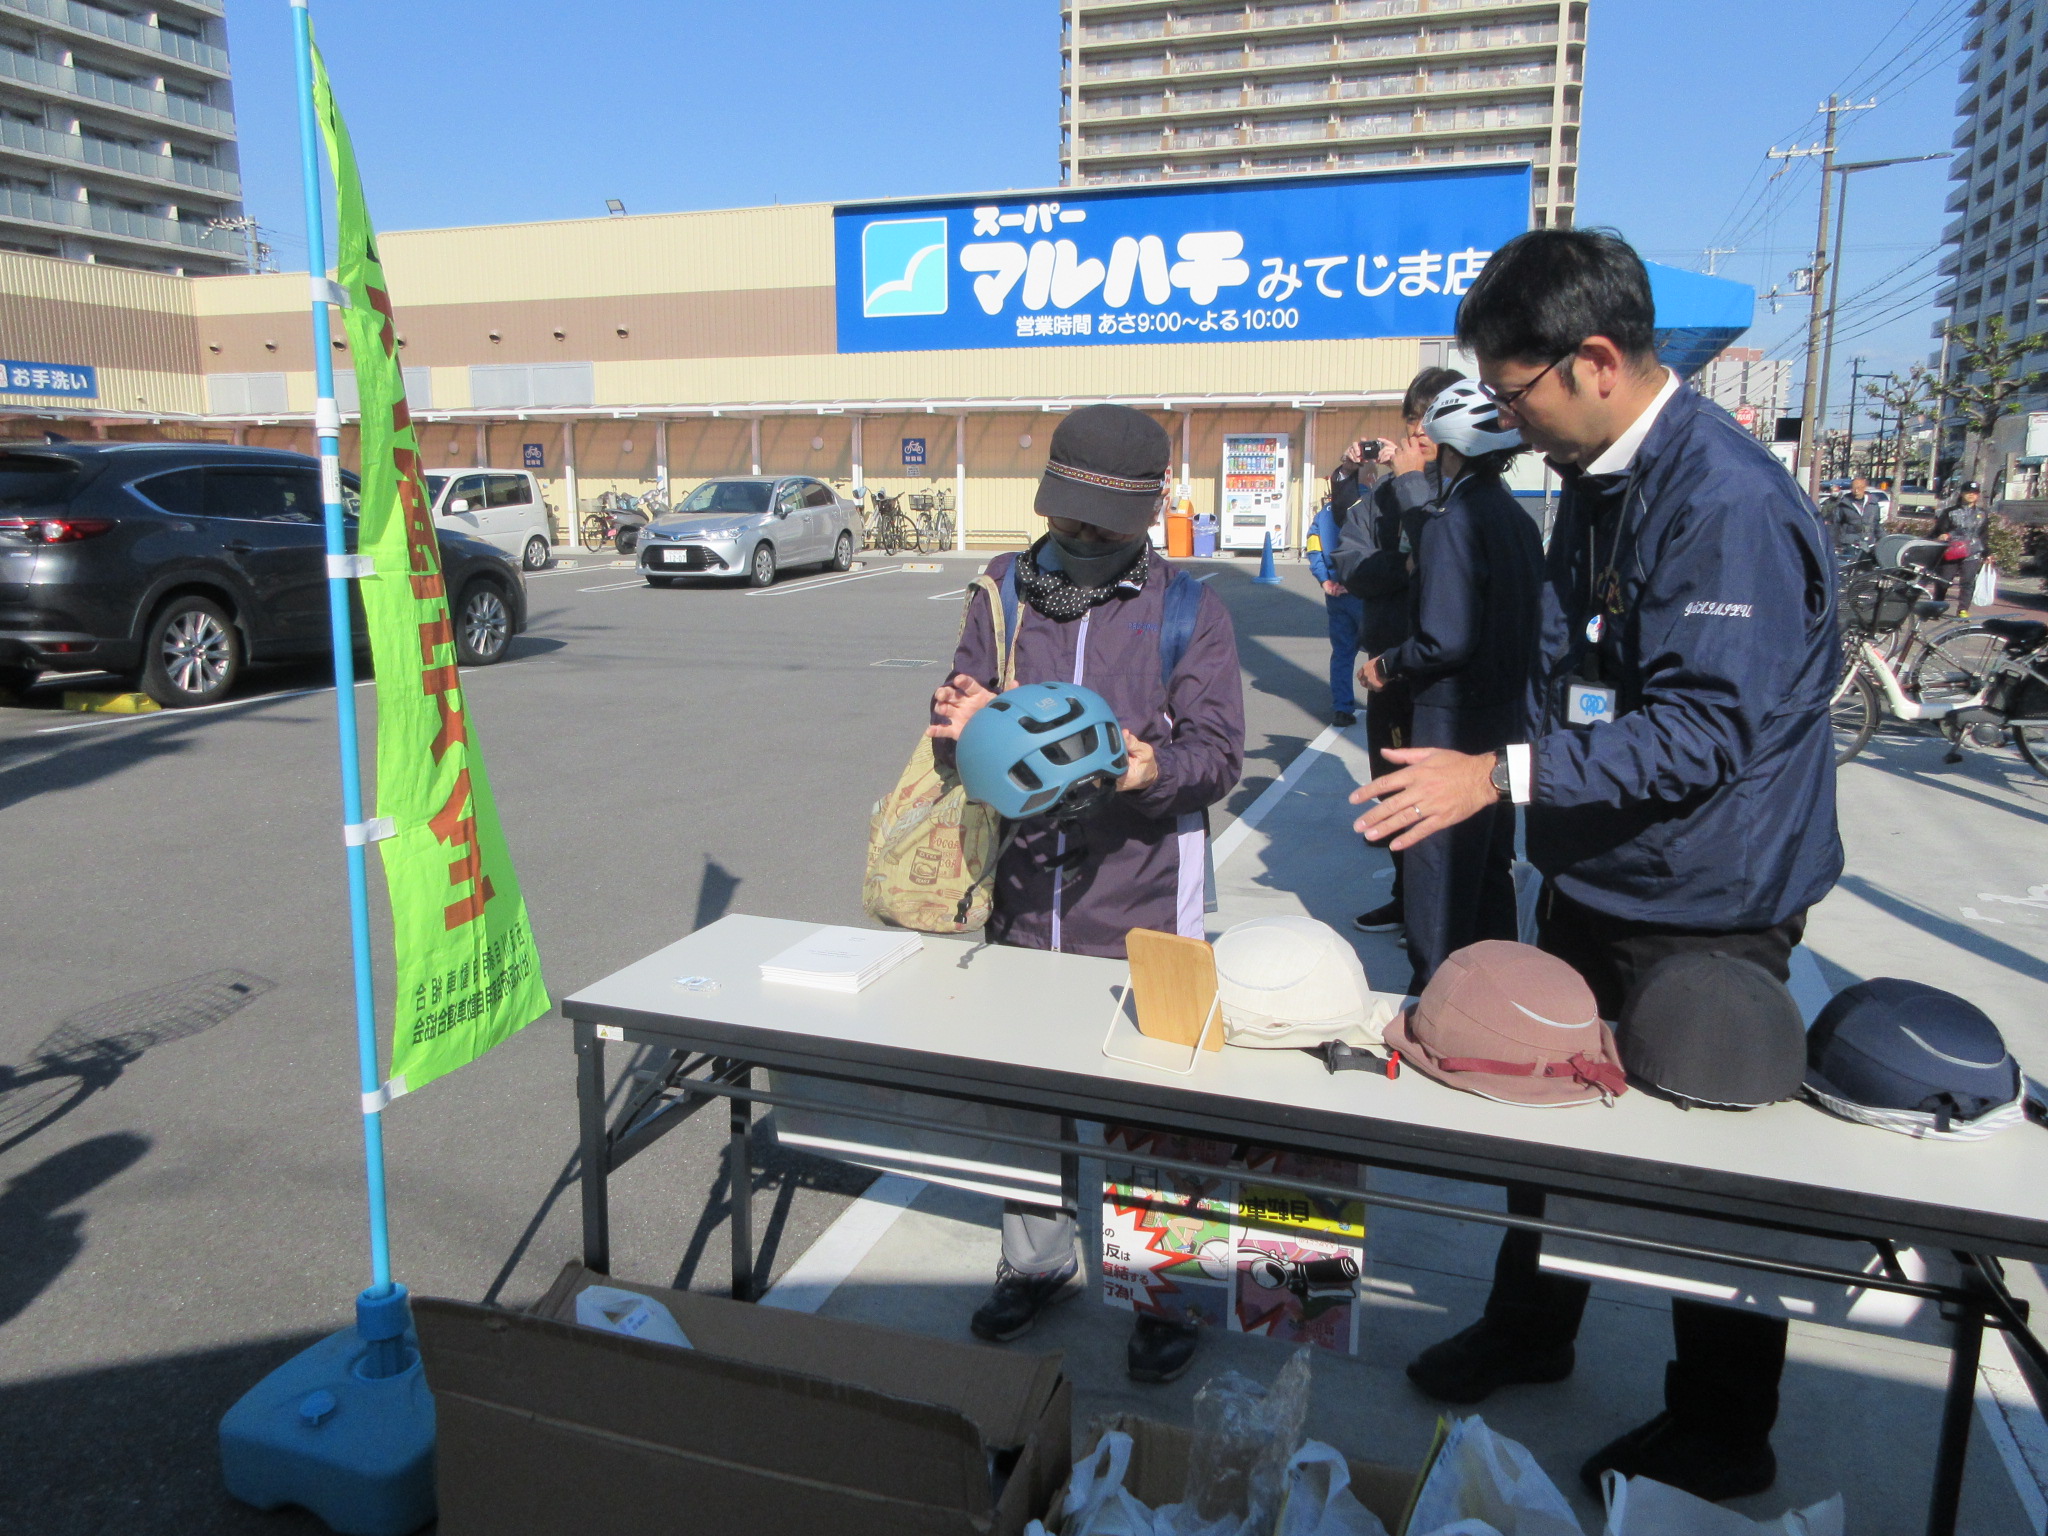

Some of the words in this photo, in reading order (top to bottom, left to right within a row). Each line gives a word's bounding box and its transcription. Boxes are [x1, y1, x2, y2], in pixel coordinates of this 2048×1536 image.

[973, 203, 1086, 236] スーパー
[959, 231, 1250, 315] マルハチ
[1257, 247, 1493, 303] みてじま店
[1016, 314, 1091, 337] 営業時間
[12, 367, 88, 390] お手洗い
[1103, 1243, 1130, 1261] 反は
